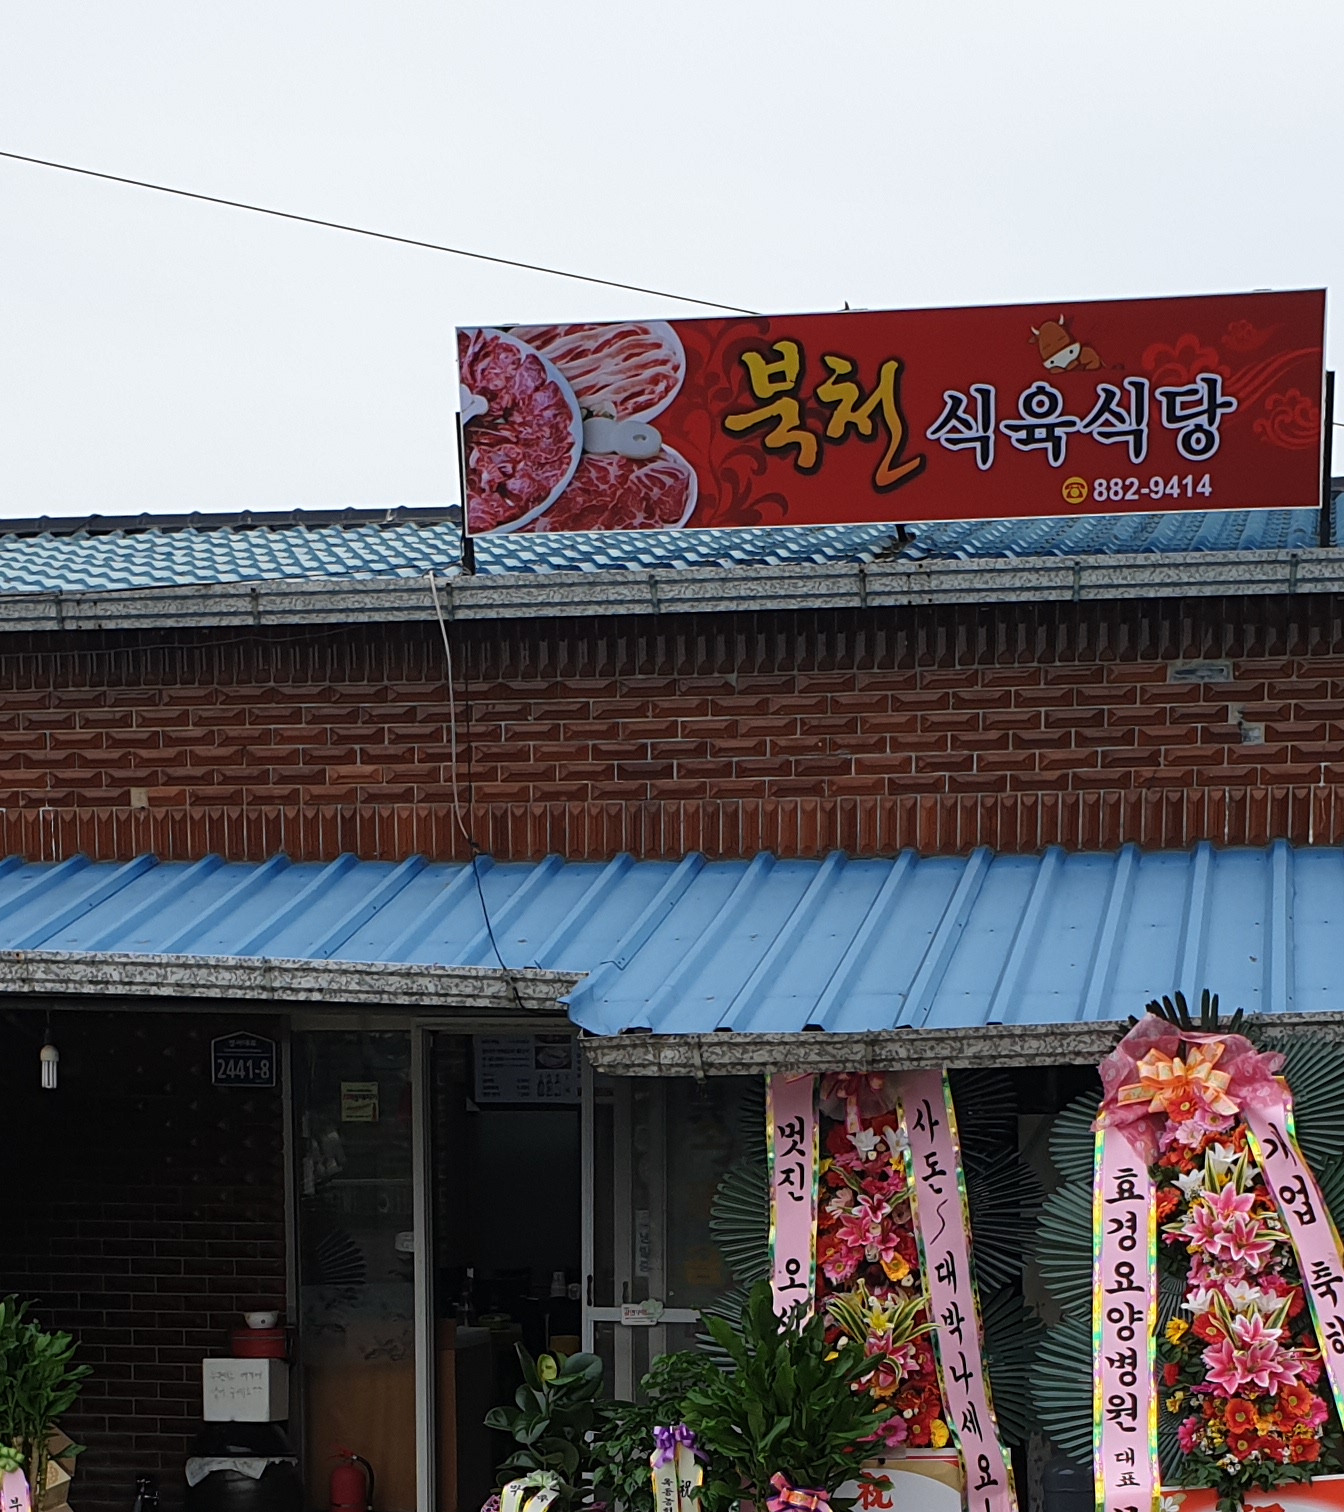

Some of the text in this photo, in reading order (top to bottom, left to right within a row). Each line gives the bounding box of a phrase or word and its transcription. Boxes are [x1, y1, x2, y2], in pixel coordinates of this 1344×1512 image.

[726, 341, 1236, 490] 북천 식육식당
[1093, 474, 1212, 502] 882-9414
[217, 1058, 270, 1079] 2441-8
[777, 1115, 807, 1202] 멋진
[1263, 1121, 1317, 1226] 개업
[1104, 1167, 1145, 1433] 효경요양병원
[856, 1471, 894, 1511] 祝
[1114, 1448, 1141, 1488] 대표
